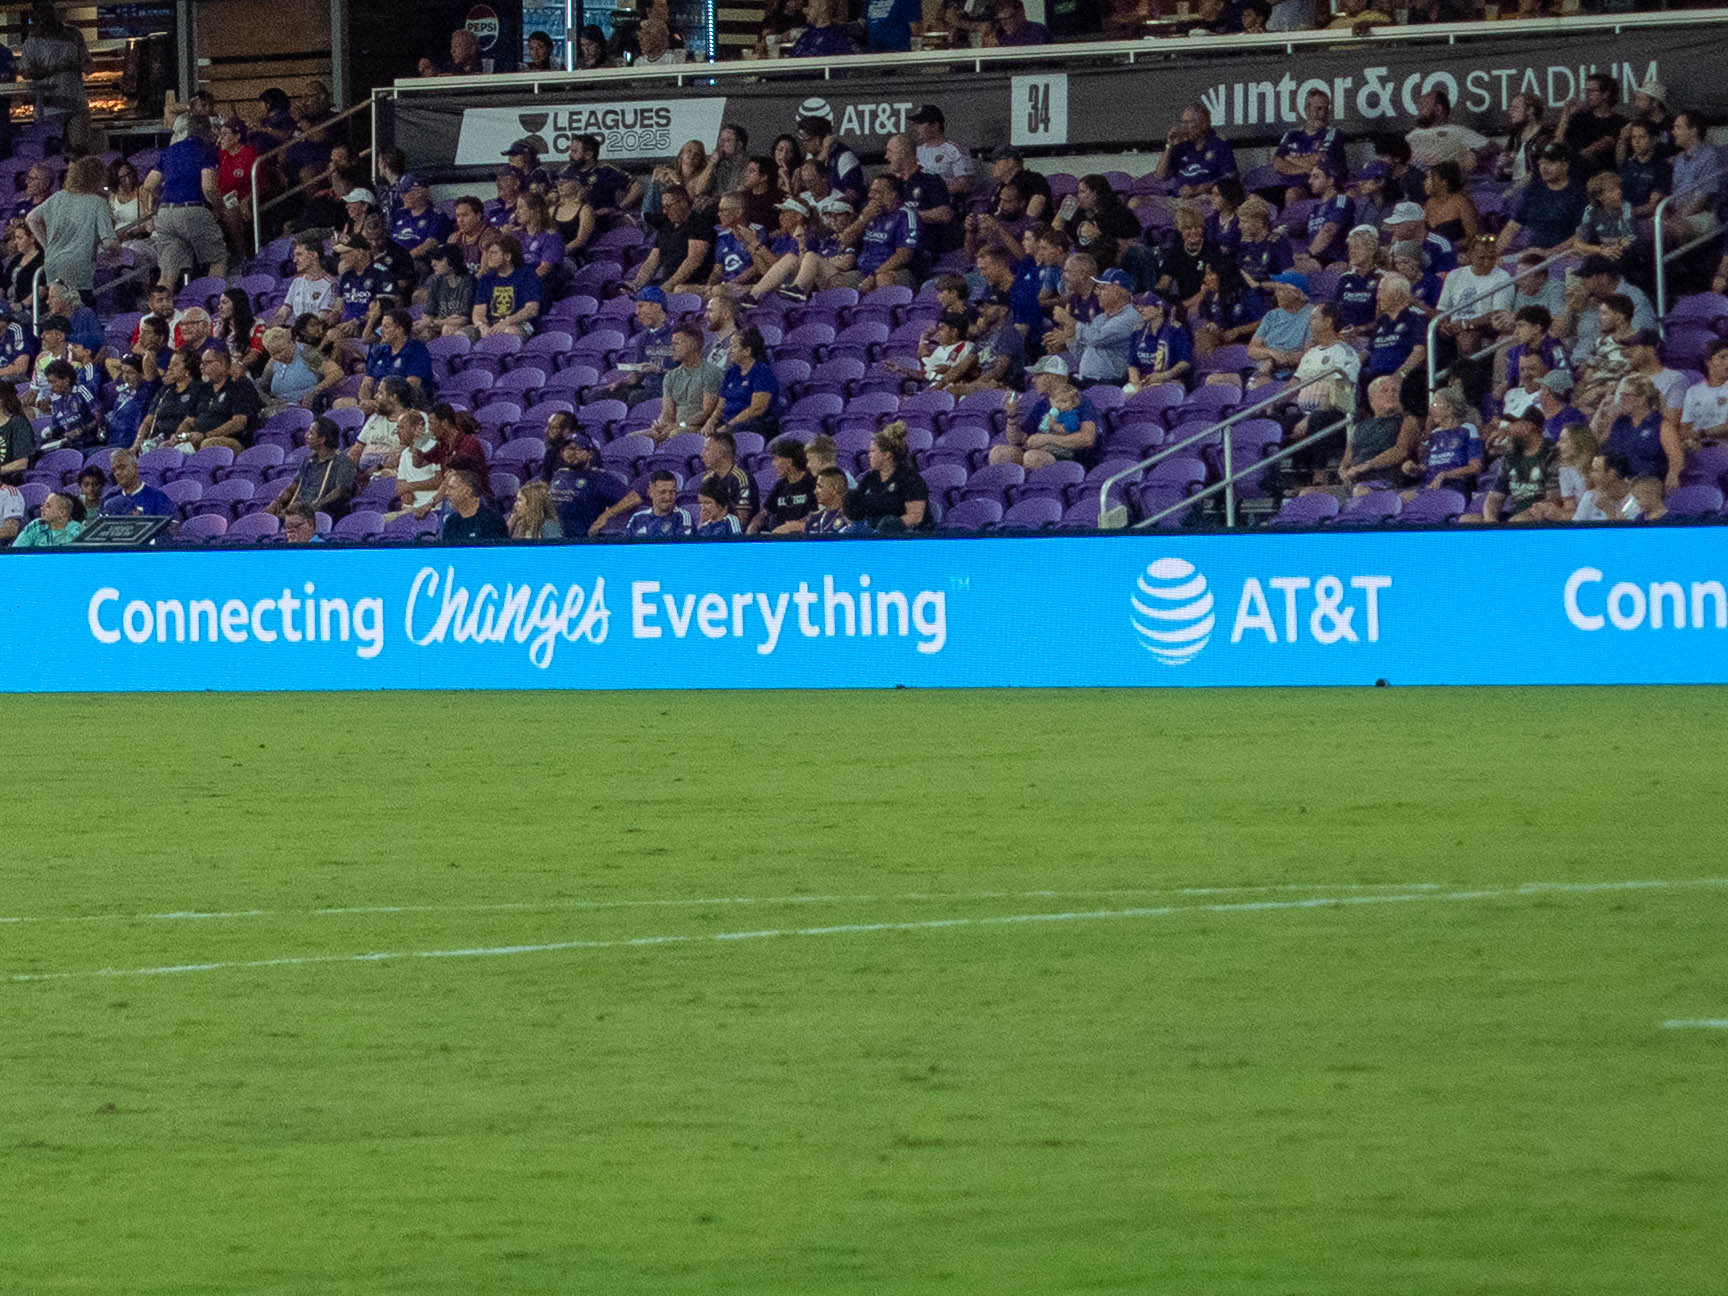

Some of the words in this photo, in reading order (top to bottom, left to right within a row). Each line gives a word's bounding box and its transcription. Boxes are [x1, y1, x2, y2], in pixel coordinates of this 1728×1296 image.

[467, 21, 499, 35] PEPSI
[552, 106, 673, 133] LEAGUES
[839, 101, 913, 136] AT&T
[1028, 82, 1052, 134] 34
[607, 130, 673, 151] 2025
[88, 588, 386, 660] Connecting
[405, 566, 612, 671] Changes
[632, 576, 948, 656] Everything
[1232, 576, 1394, 646] AT&T
[1564, 568, 1728, 632] Conn
